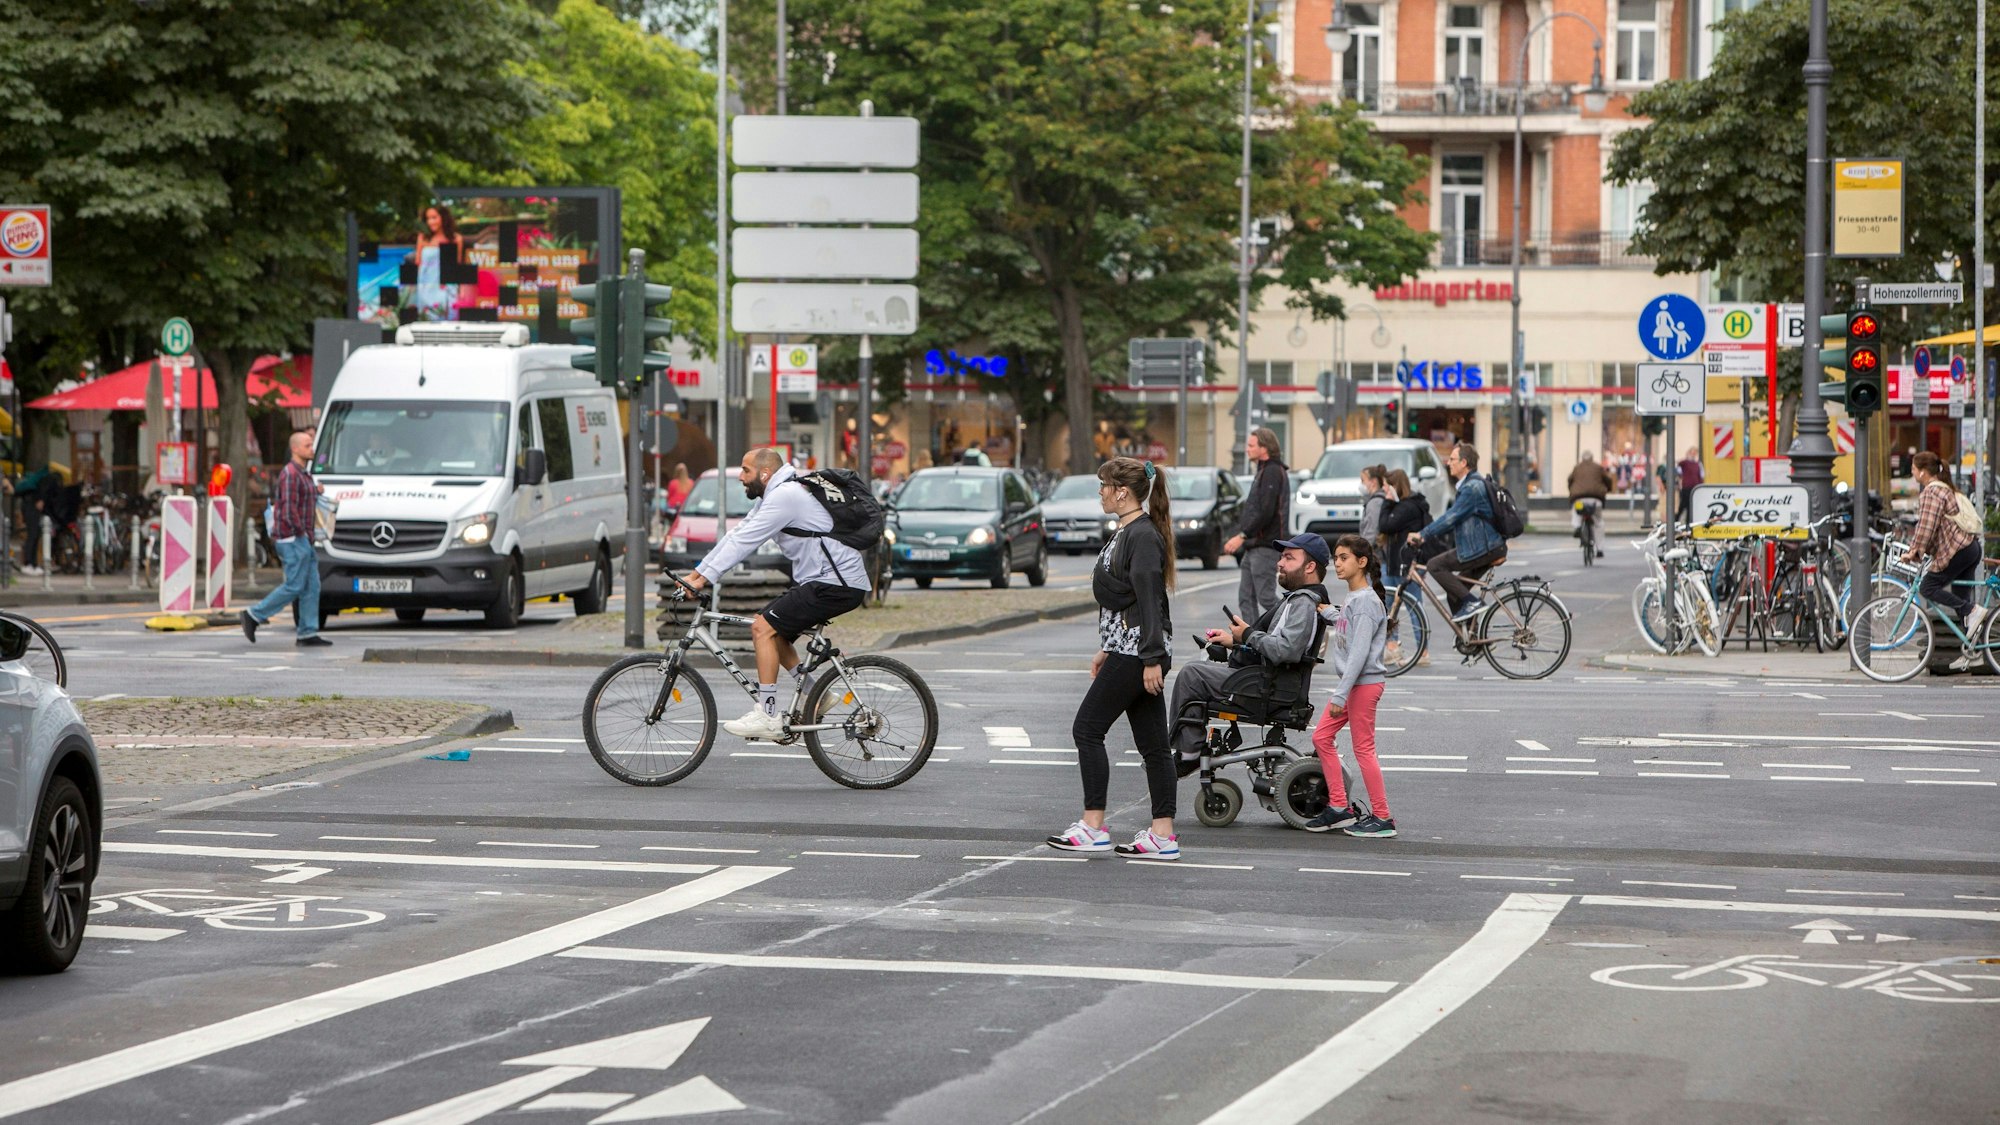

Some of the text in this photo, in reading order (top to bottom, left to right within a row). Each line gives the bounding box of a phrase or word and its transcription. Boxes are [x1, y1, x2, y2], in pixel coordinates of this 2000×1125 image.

[1838, 215, 1898, 223] Friesenstraße
[8, 230, 38, 246] KING
[1874, 286, 1958, 300] Hohenzollernring
[1731, 316, 1744, 333] H
[1789, 318, 1804, 337] B
[754, 353, 767, 367] A
[1406, 360, 1482, 390] Kids
[1661, 396, 1682, 408] frei
[369, 490, 447, 500] SCHENKER
[1713, 489, 1735, 500] der
[1744, 494, 1793, 507] parkett
[1707, 502, 1779, 523] Riese
